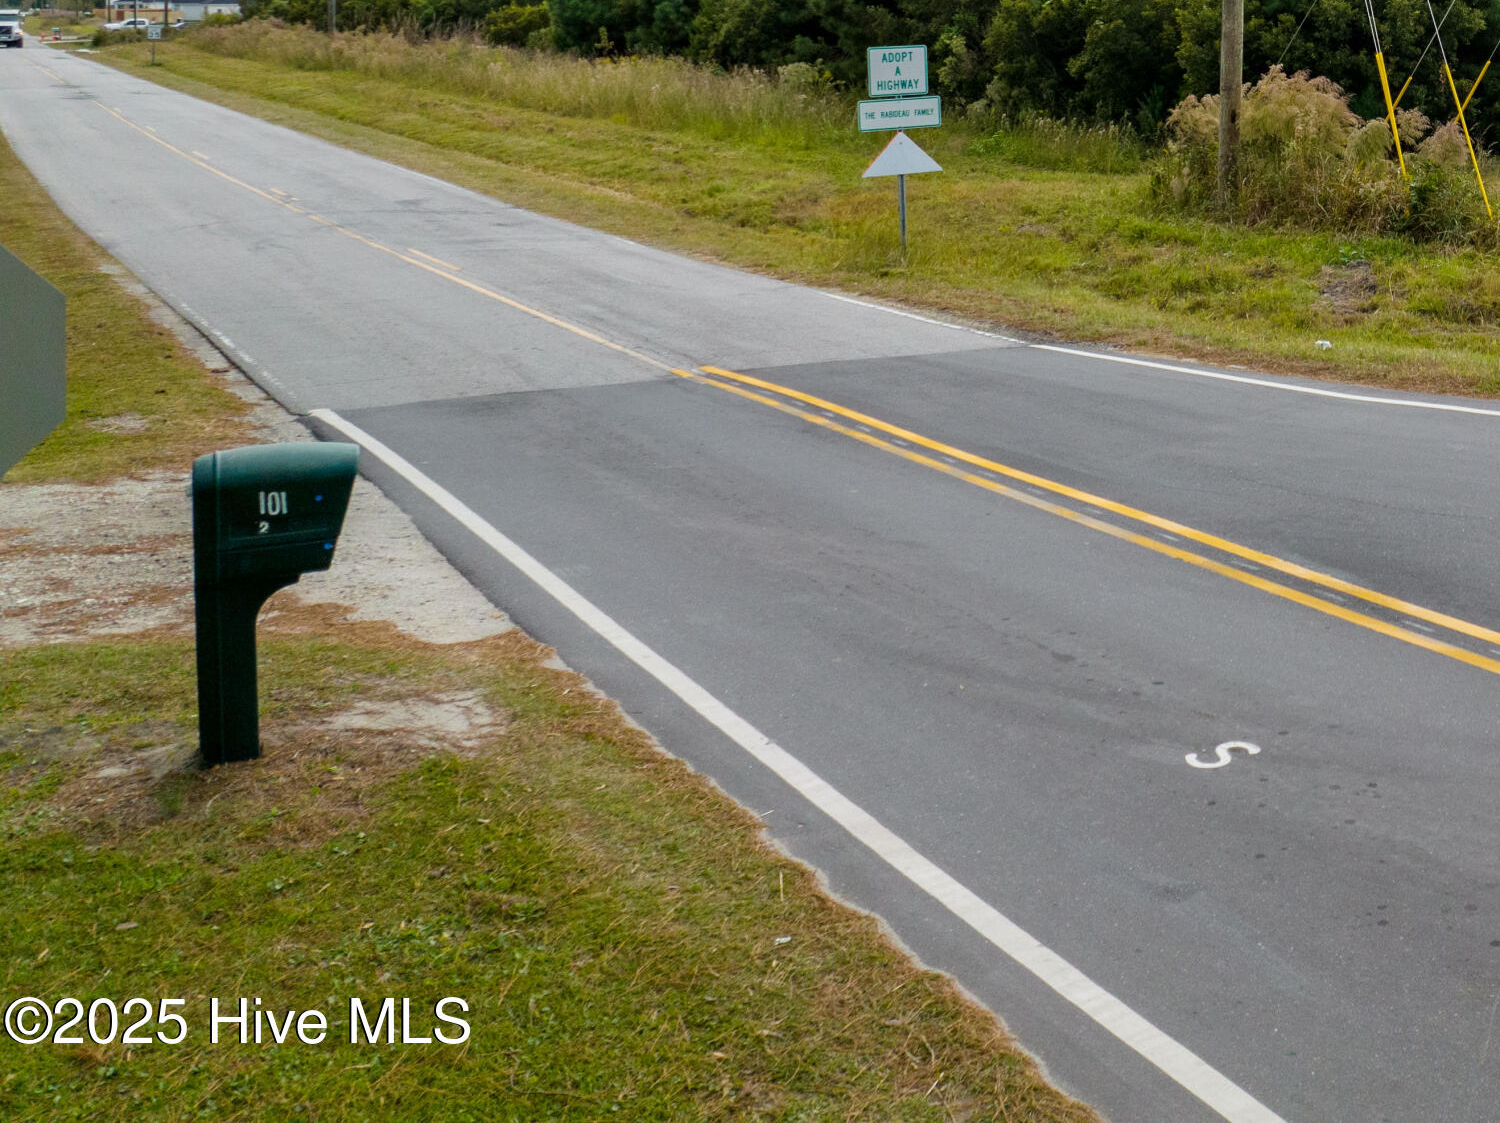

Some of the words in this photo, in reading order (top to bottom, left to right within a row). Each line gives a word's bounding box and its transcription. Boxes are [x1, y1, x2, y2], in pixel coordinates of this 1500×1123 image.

[881, 52, 913, 63] ADOPT
[895, 66, 902, 76] A
[877, 79, 919, 90] HIGHWAY
[864, 112, 876, 120] THE
[914, 108, 934, 116] FAMILY
[259, 491, 287, 515] 101
